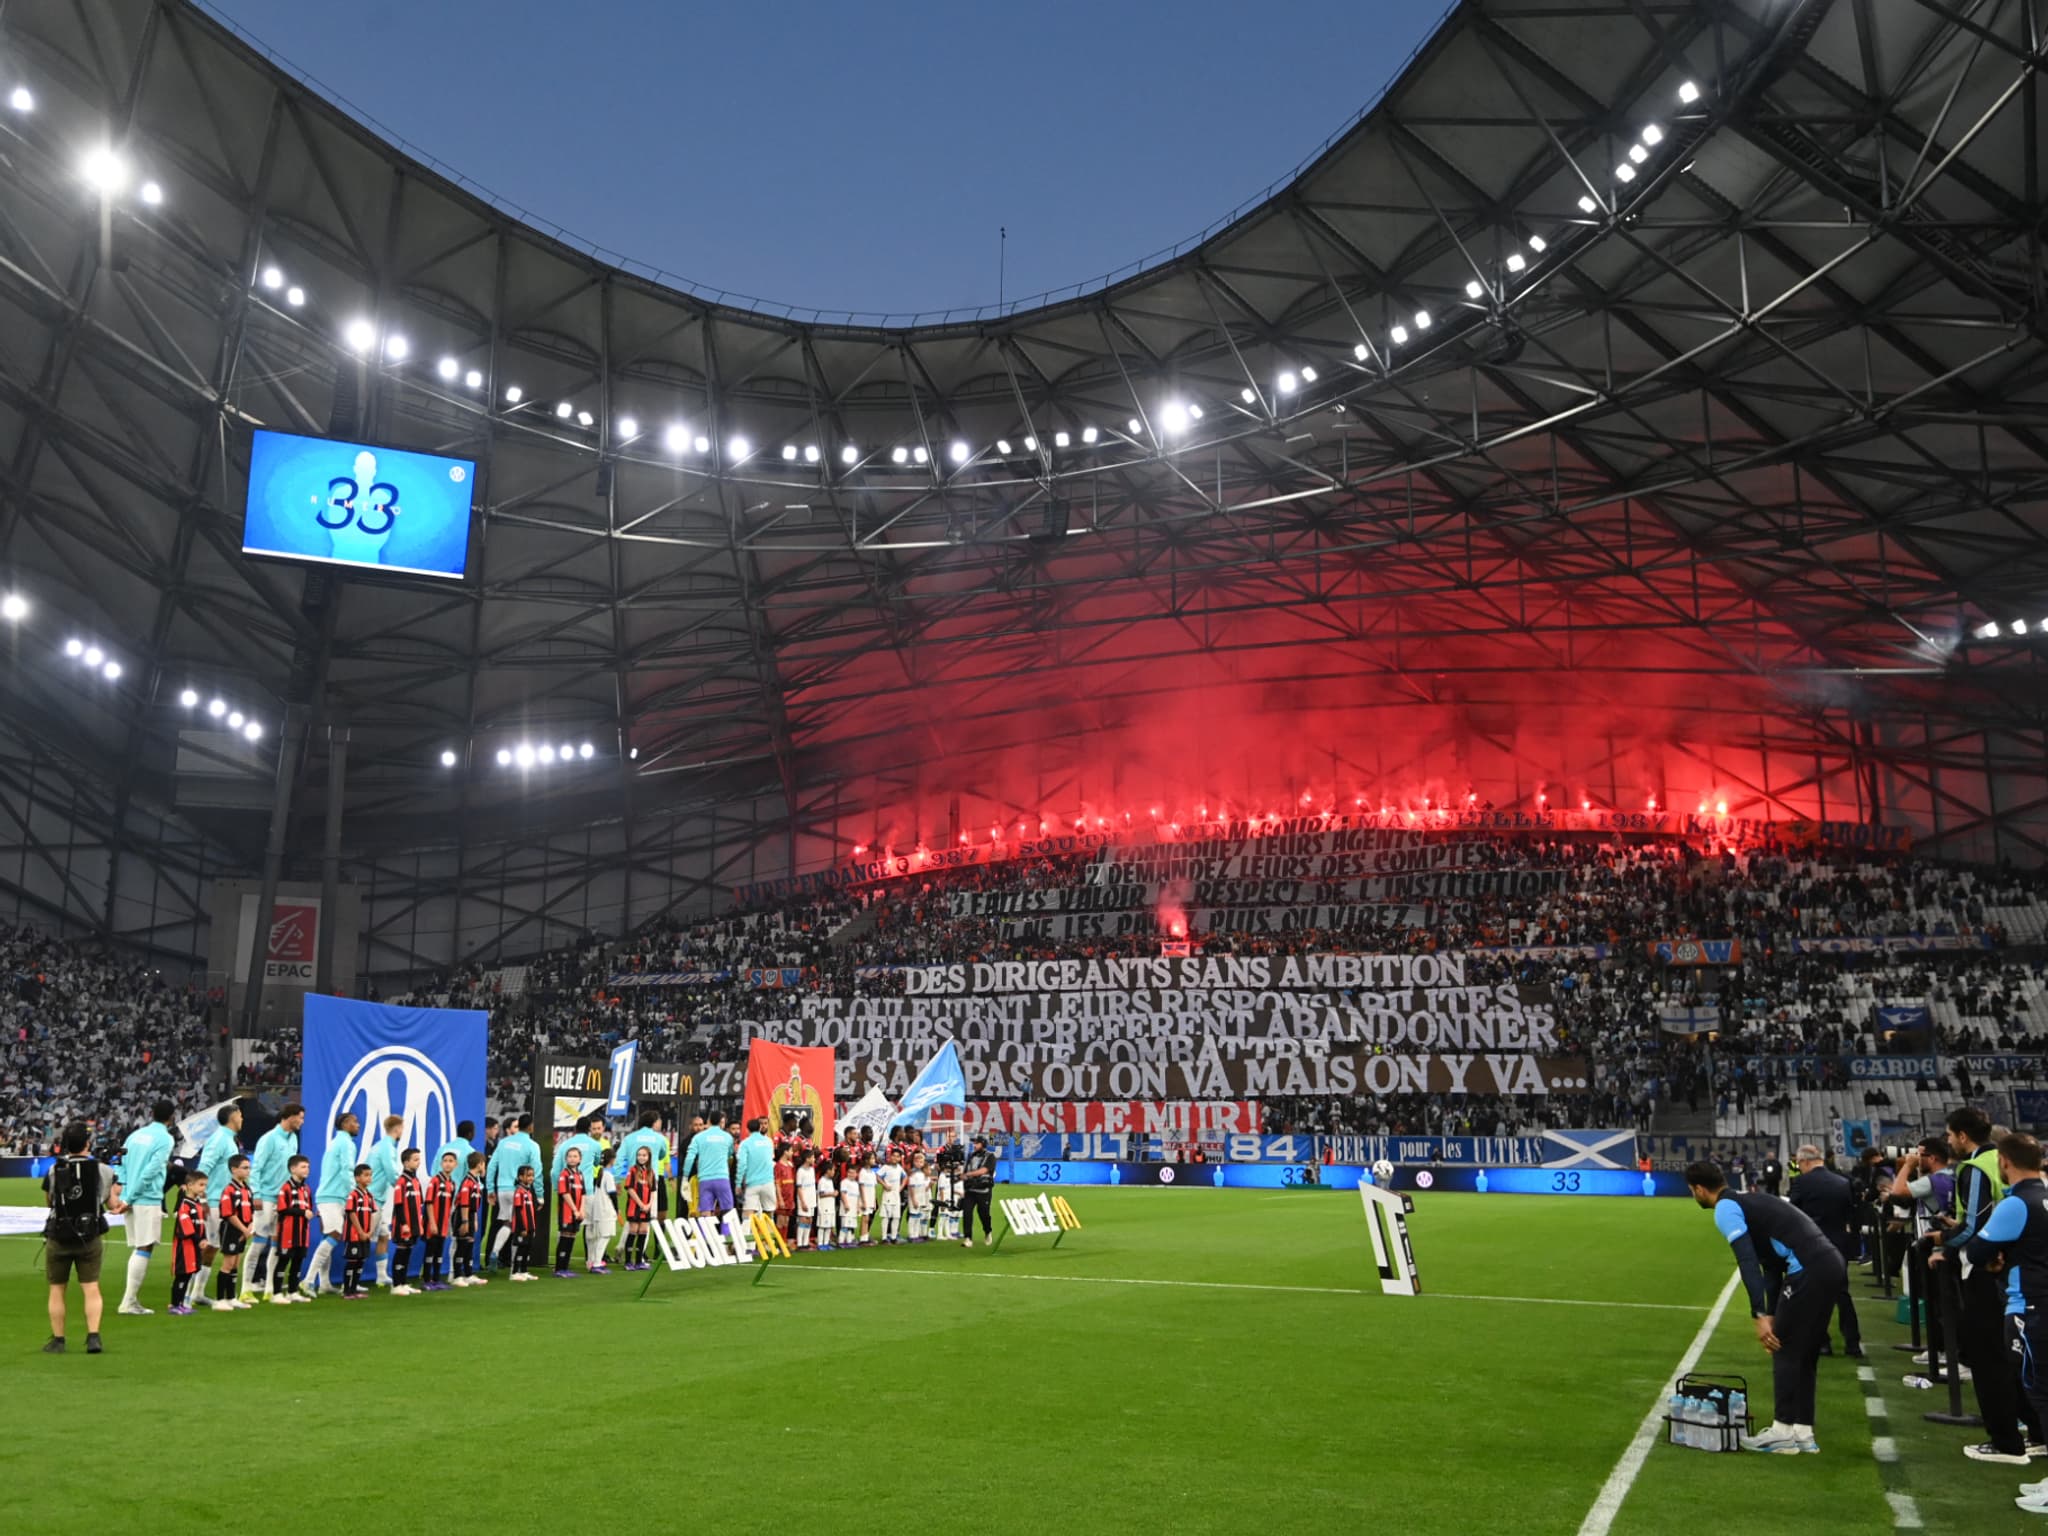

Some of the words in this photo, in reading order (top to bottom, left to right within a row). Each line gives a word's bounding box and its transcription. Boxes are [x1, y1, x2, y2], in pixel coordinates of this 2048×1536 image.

[316, 477, 399, 535] 33
[1358, 812, 1554, 828] MARSEILLE
[1598, 813, 1669, 832] 1987
[1253, 833, 1325, 857] LEURS
[1334, 828, 1422, 853] AGENTS
[1108, 856, 1233, 885] DEMANDEZ
[1239, 854, 1314, 879] LEURS
[1321, 851, 1365, 876] DES
[1373, 842, 1497, 873] COMPTES
[970, 890, 1049, 915] FAITES
[1059, 883, 1147, 911] VALOIR
[1193, 879, 1304, 904] RESPECT
[1316, 880, 1348, 901] DE
[1023, 917, 1054, 937] NE
[1065, 913, 1105, 939] LES
[1209, 909, 1272, 935] PLUS
[1281, 906, 1319, 934] OU
[1328, 904, 1410, 934] VIREZ
[1424, 902, 1472, 928] LES
[904, 963, 967, 995] DES
[973, 958, 1173, 992] DIRIGEANTS
[1180, 956, 1272, 989] SANS
[1279, 953, 1466, 988] AMBITION
[1039, 989, 1152, 1019] LEURS
[738, 1018, 804, 1050] DES
[809, 1015, 955, 1047] JOUEURS
[961, 1017, 1024, 1043] QUI
[1030, 1009, 1255, 1045] PREFERENT
[1266, 1007, 1559, 1049] ABANDONNER
[998, 1039, 1076, 1064] QUE
[1084, 1034, 1330, 1063] COMBATTRE
[544, 1065, 575, 1090] LIGUE
[965, 1060, 1034, 1096] PAS
[1109, 1060, 1169, 1099] ON
[1178, 1056, 1234, 1098] VA
[1244, 1055, 1358, 1096] MAIS
[1364, 1054, 1431, 1094] ON
[1440, 1054, 1475, 1094] Y
[1851, 1058, 1936, 1077] GARDE
[642, 1072, 671, 1094] LIGUE
[953, 1101, 1066, 1133] DANS
[1072, 1101, 1133, 1133] LE
[1230, 1134, 1299, 1162] 84
[1399, 1140, 1431, 1164] pour
[1441, 1137, 1463, 1160] les
[1473, 1137, 1544, 1165] ULTRAS
[1037, 1163, 1062, 1182] 33
[1552, 1171, 1581, 1192] 33
[651, 1215, 738, 1272] LIGUE
